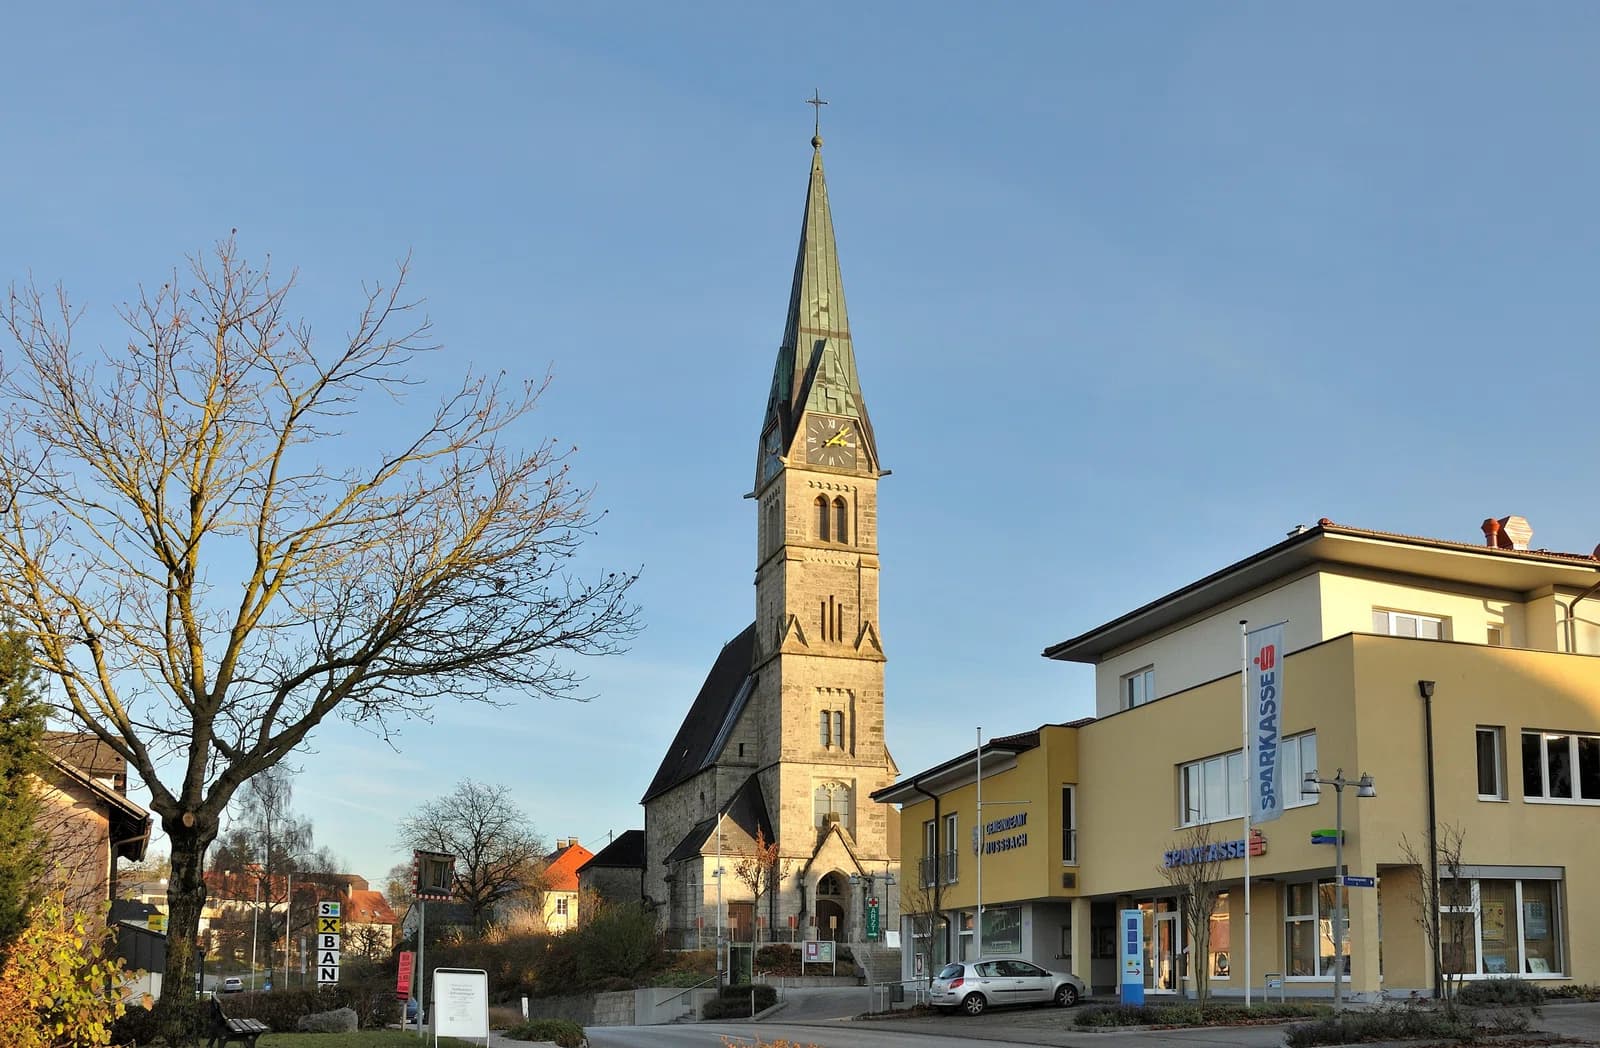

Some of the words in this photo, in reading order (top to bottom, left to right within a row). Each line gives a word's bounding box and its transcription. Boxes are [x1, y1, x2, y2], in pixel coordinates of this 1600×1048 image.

[1258, 671, 1277, 810] SPARKASSE
[985, 837, 1028, 855] NUSSBACH
[321, 936, 335, 984] BAN
